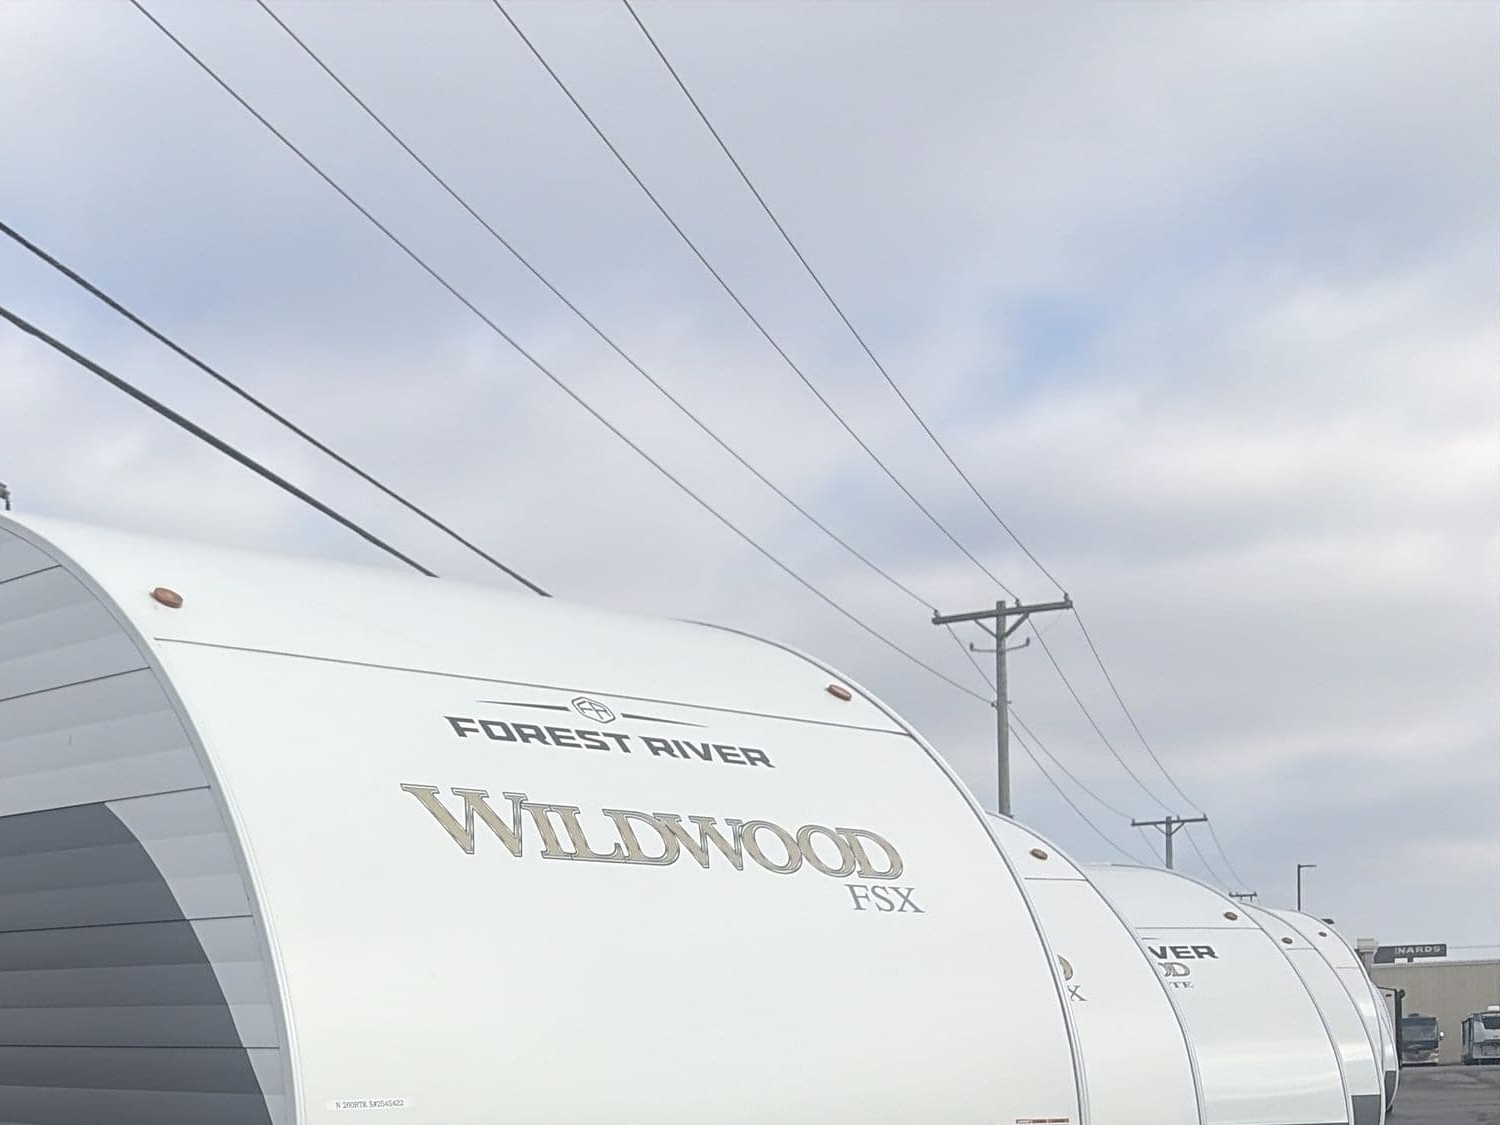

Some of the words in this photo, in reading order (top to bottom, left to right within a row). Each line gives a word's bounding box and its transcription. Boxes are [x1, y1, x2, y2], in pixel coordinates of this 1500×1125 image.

[443, 715, 631, 754] FOREST
[638, 735, 776, 769] RIVER
[845, 883, 925, 914] FSX
